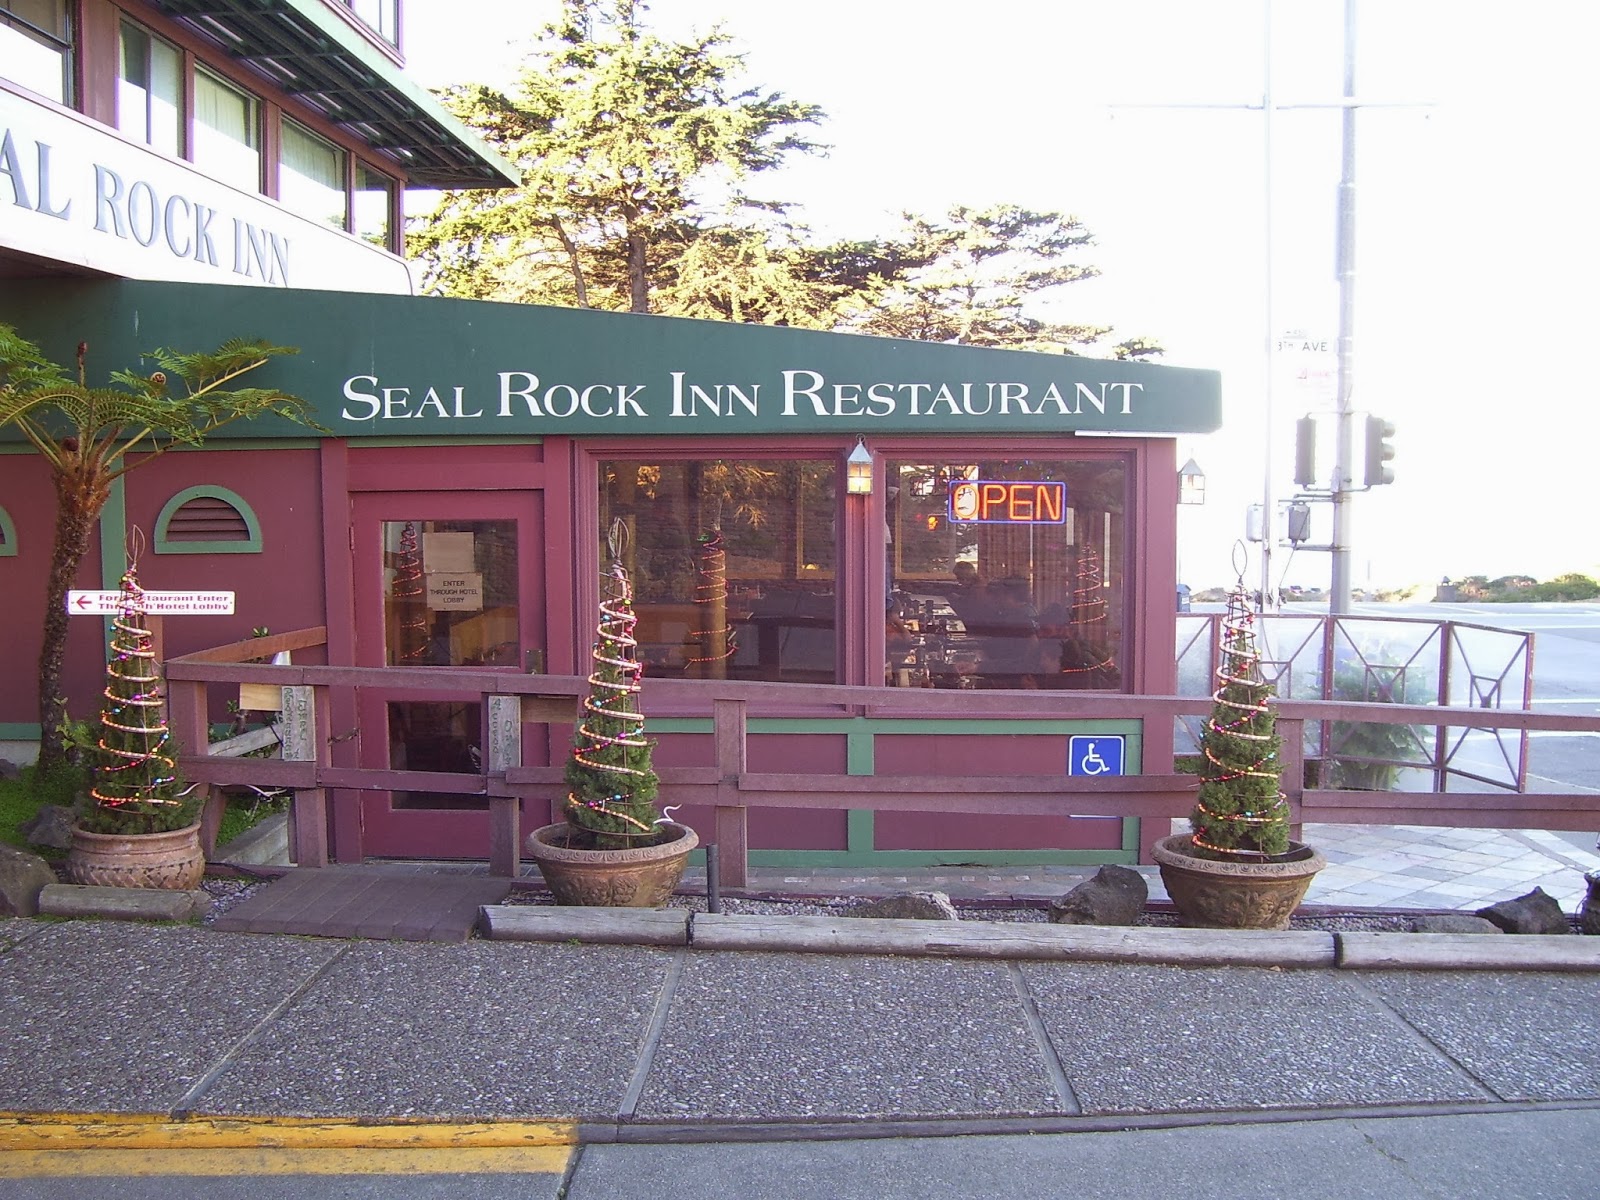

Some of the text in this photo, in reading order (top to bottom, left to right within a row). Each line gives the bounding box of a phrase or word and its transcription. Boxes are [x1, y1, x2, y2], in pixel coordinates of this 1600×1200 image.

[93, 163, 219, 267] ROCK
[232, 217, 292, 288] INN
[1301, 341, 1328, 352] AVE
[341, 369, 1144, 421] SEAL ROCK INN RESTAURANT
[953, 484, 1061, 521] OPEN
